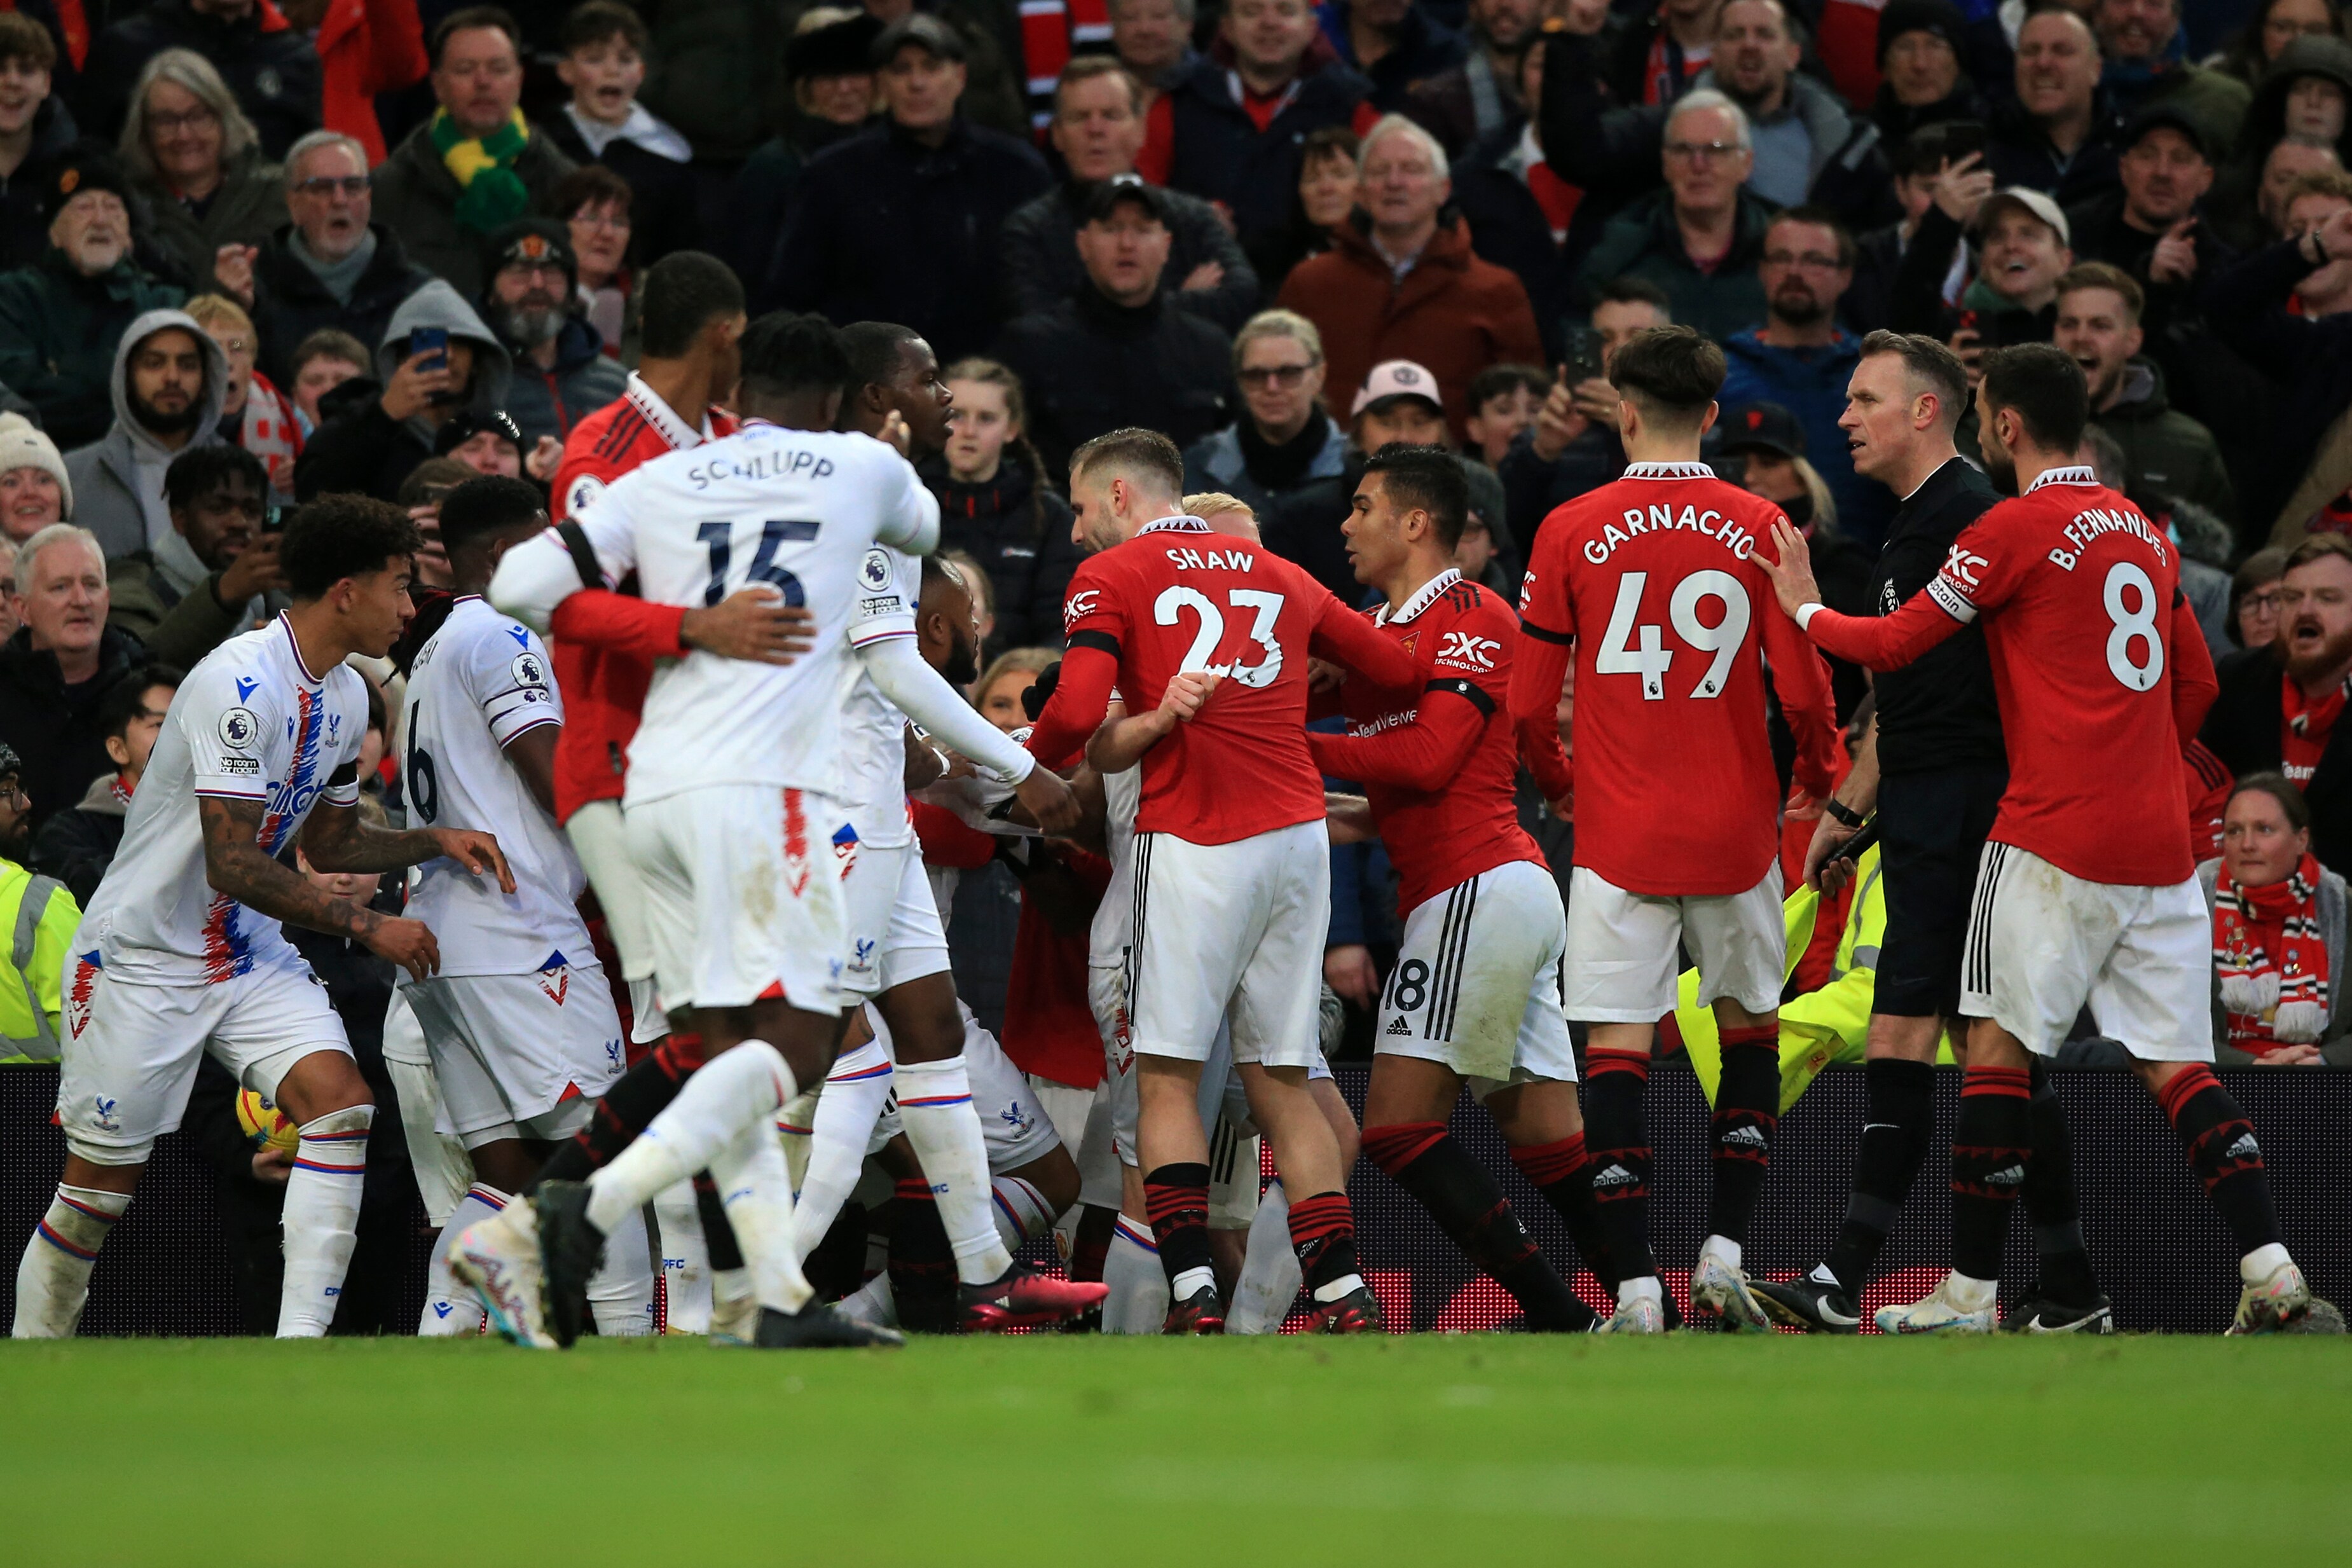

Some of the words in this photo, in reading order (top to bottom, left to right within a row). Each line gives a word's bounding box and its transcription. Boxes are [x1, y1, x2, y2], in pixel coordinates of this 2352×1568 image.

[689, 451, 834, 490] SCHLUPP
[1584, 504, 1756, 565] GARNACHO
[696, 521, 820, 623] 15
[1166, 547, 1253, 573] SHAW
[861, 600, 874, 608] No
[1929, 580, 1959, 612] ptain
[1153, 585, 1284, 687] 23
[1596, 569, 1751, 700] 49
[2103, 561, 2164, 692] 8
[219, 757, 233, 766] No
[408, 699, 437, 825] 6
[1385, 958, 1429, 1012] 18
[1386, 1027, 1412, 1036] adidas
[1721, 1134, 1768, 1149] adidas
[1593, 1174, 1639, 1187] adidas
[663, 1259, 685, 1269] PFC
